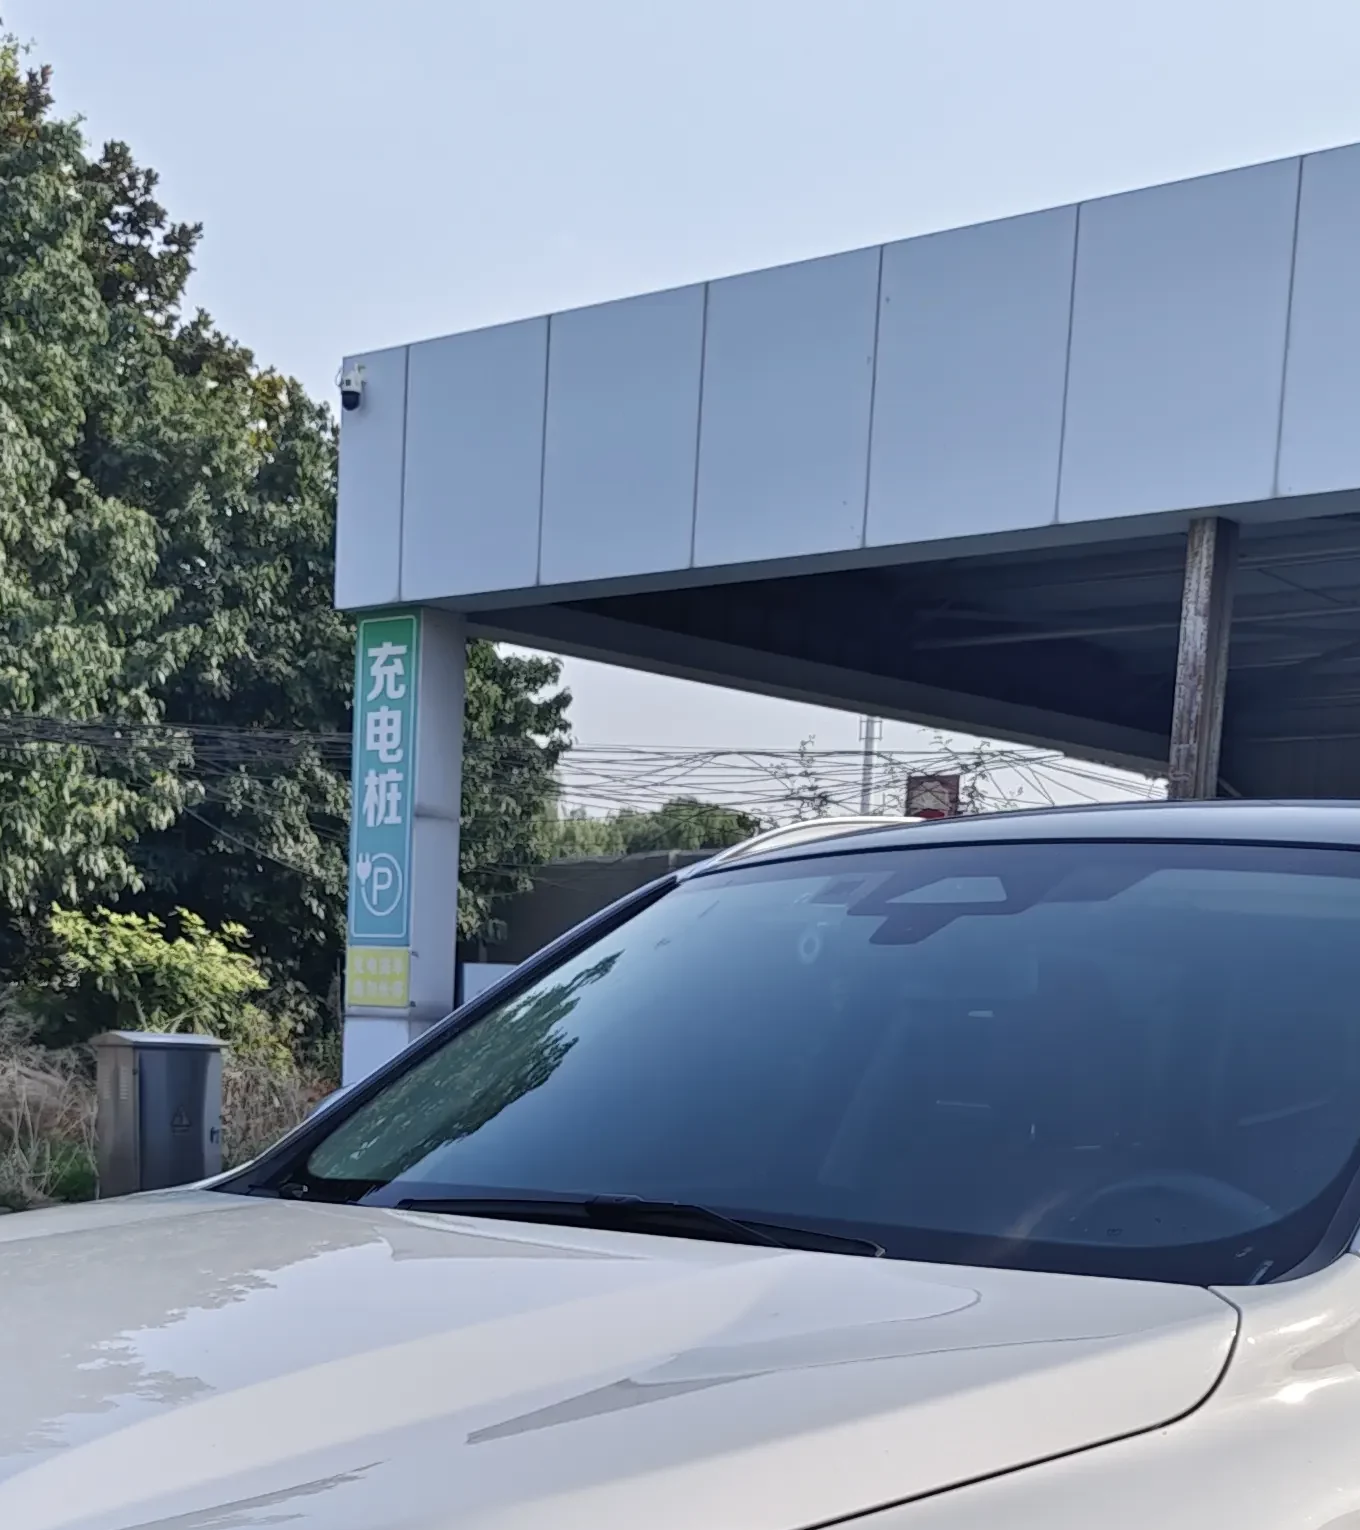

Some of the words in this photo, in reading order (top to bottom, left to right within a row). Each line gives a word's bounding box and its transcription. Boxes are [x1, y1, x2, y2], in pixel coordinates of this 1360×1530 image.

[362, 641, 408, 828] 充电桩
[372, 867, 393, 906] P
